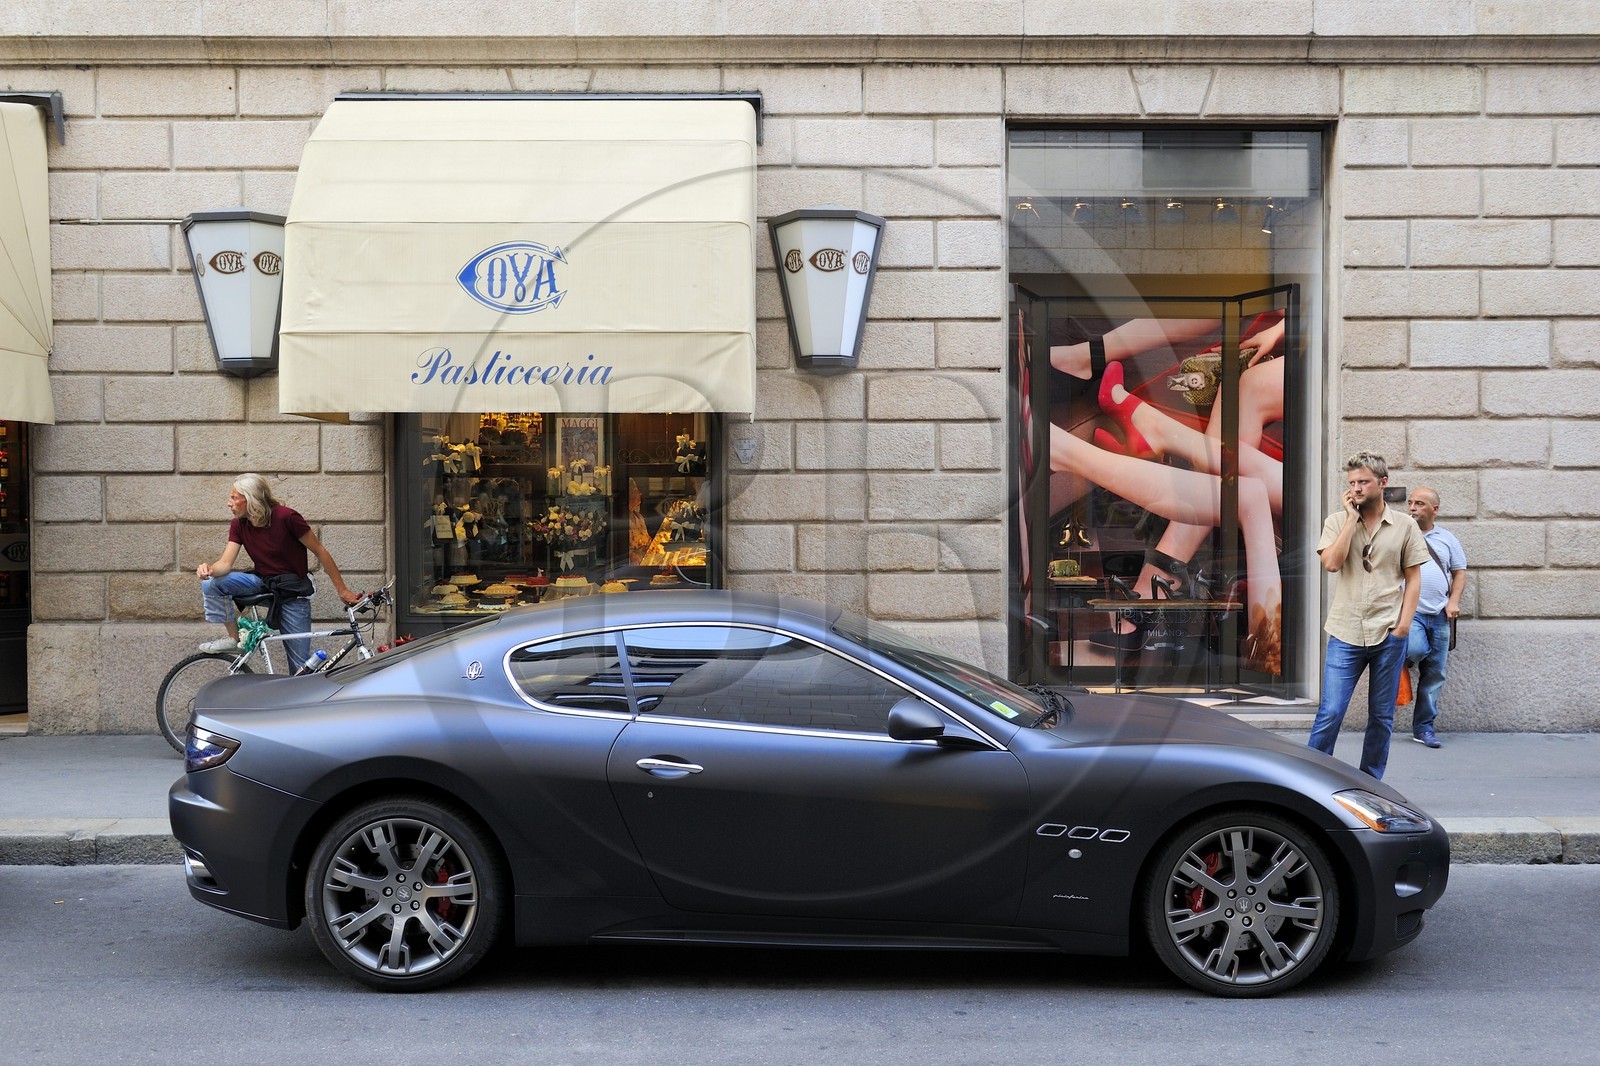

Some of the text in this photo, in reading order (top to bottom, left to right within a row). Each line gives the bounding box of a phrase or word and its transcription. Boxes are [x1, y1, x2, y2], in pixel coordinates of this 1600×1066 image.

[411, 347, 614, 385] Pasticceria
[562, 418, 598, 428] MAGGI
[1147, 629, 1182, 637] MILANO
